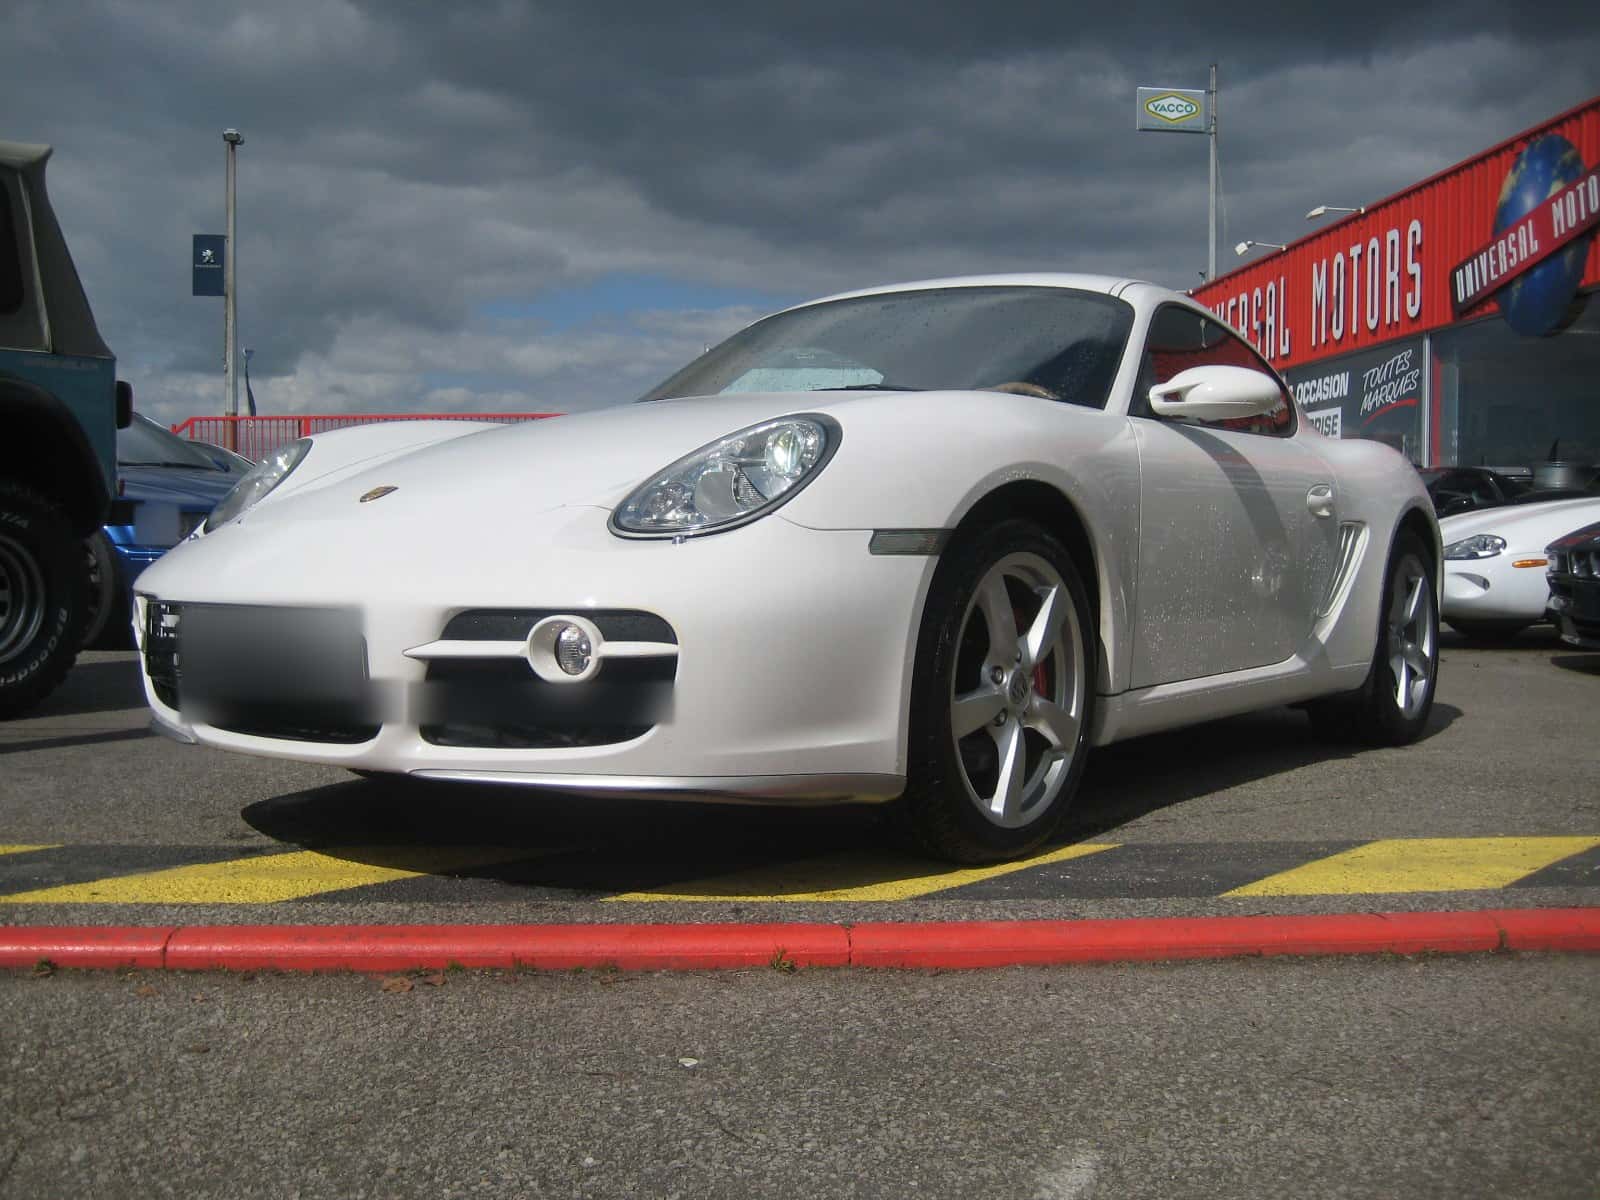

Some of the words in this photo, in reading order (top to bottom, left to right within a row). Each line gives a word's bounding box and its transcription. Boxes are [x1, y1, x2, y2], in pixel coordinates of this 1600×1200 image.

[1152, 103, 1193, 113] YACCO
[1312, 219, 1421, 346] MOTORS
[1456, 219, 1538, 302] UNIVERSAL
[1296, 371, 1349, 405] OCCASION
[1360, 368, 1419, 416] MARQUES
[1363, 349, 1412, 392] TOUTES
